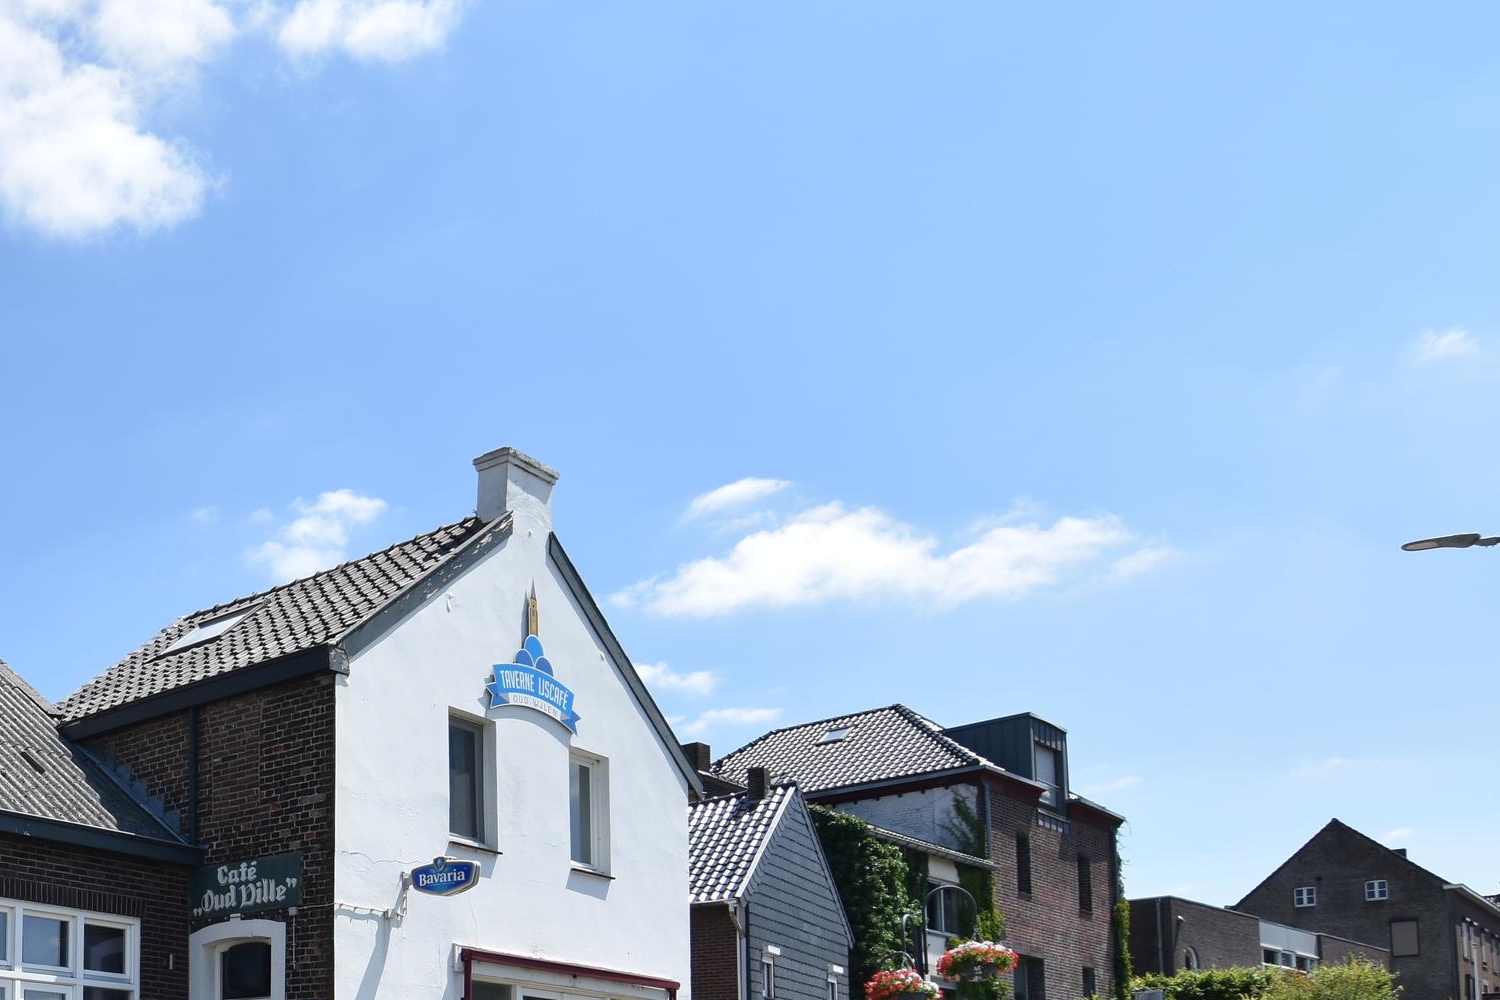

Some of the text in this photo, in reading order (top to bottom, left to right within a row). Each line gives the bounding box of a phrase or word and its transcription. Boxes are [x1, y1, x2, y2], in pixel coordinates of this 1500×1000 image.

[499, 669, 569, 711] TAVERNE IJSCAFÉ
[217, 860, 257, 886] Café
[419, 868, 466, 887] Bavaria
